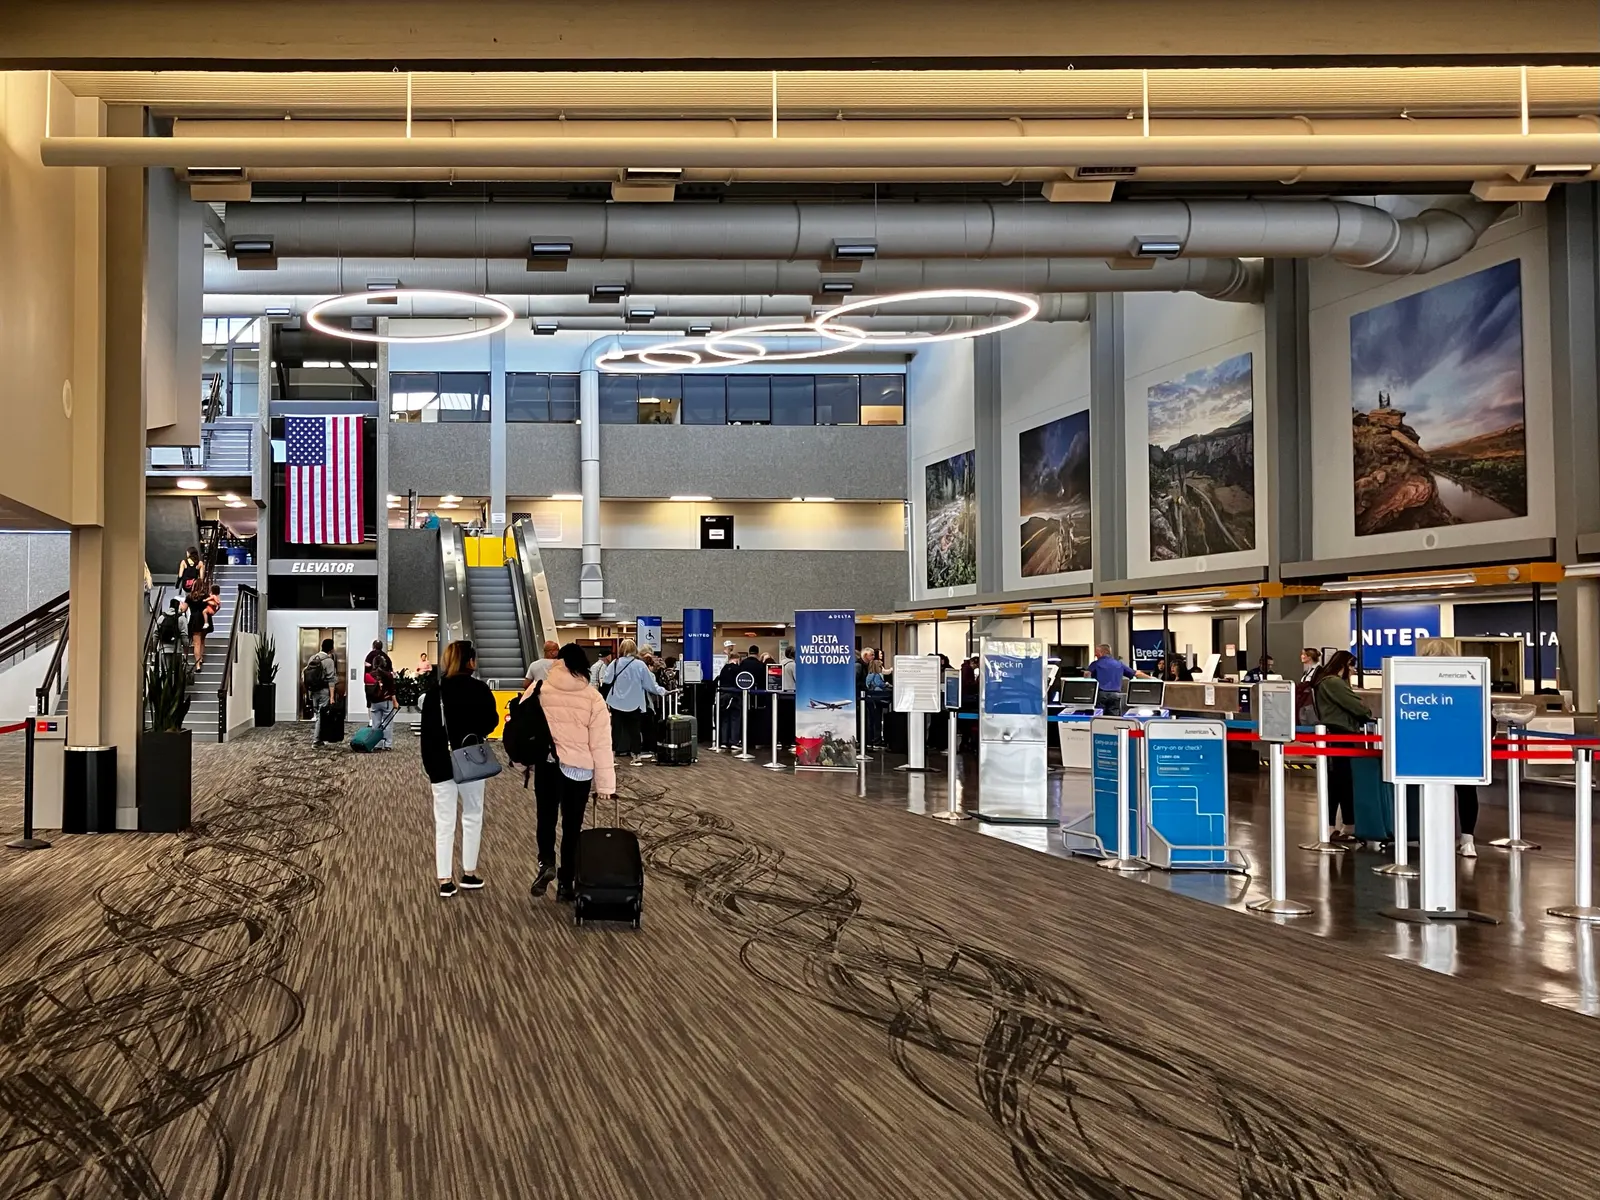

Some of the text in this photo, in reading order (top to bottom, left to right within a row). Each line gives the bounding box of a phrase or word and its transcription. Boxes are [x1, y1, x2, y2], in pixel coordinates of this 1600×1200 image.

[292, 562, 355, 573] ELEVATOR
[811, 634, 838, 644] DELTA
[800, 645, 850, 654] WELCOMES
[800, 655, 851, 664] YOU TODAY
[1015, 661, 1024, 669] in
[1400, 693, 1454, 705] Check in
[1400, 708, 1432, 720] here.
